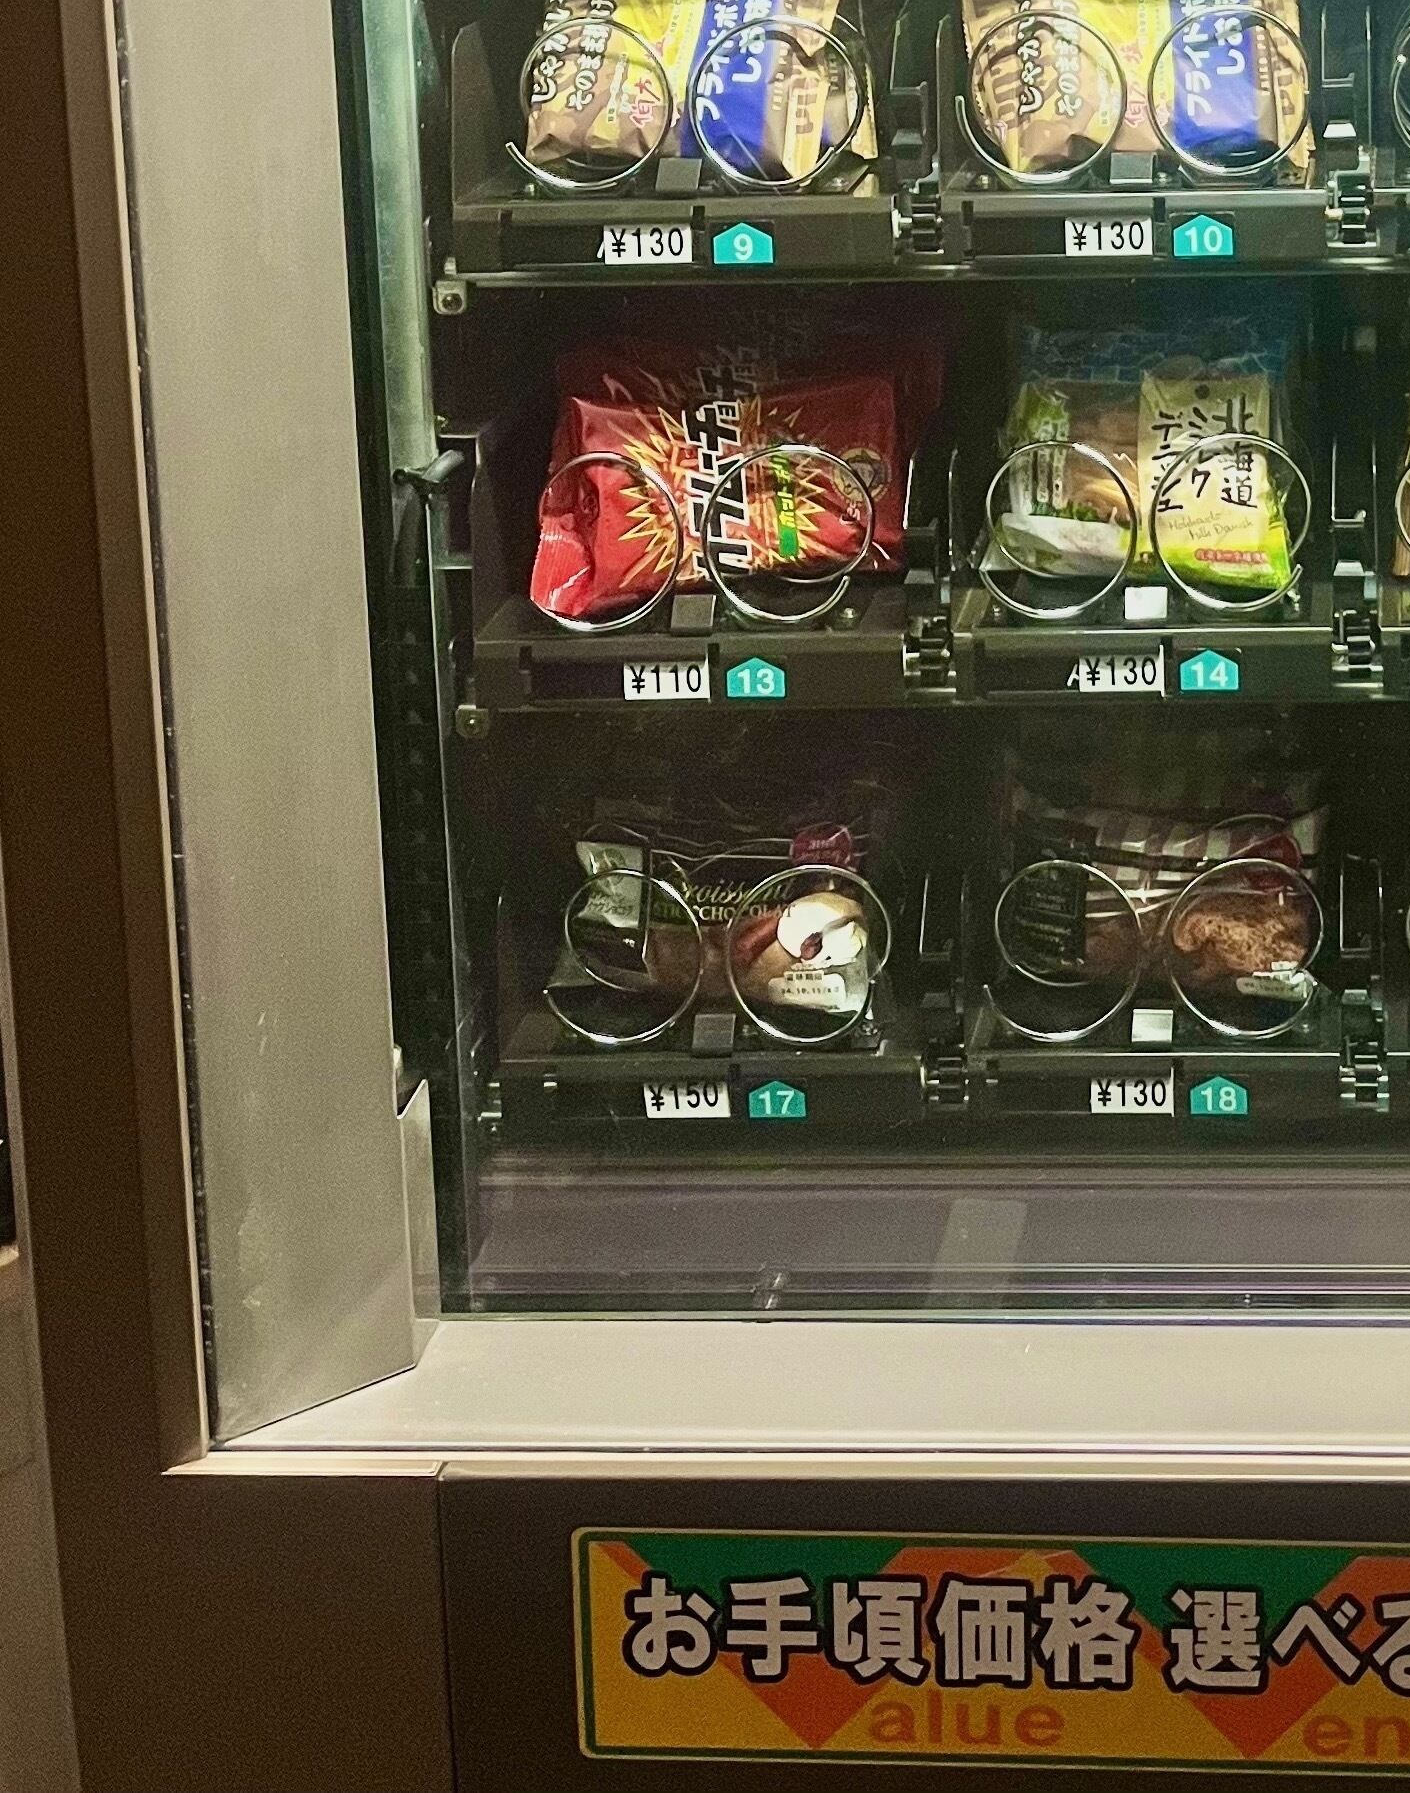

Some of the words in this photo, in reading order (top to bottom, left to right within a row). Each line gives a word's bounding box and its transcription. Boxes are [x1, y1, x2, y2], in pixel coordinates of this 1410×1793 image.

[610, 228, 685, 258] ¥130
[733, 233, 754, 261] 9
[1071, 222, 1146, 251] ¥130
[1184, 226, 1223, 254] 10
[1212, 392, 1259, 509] 北海道
[631, 664, 702, 694] ¥110
[737, 668, 775, 694] 13
[1085, 658, 1157, 686] ¥130
[1190, 663, 1228, 687] 14
[649, 1083, 720, 1112] ¥150
[757, 1090, 796, 1115] 17
[1096, 1078, 1168, 1108] ¥130
[1200, 1086, 1237, 1112] 18
[625, 1573, 1136, 1689] お手頃価格
